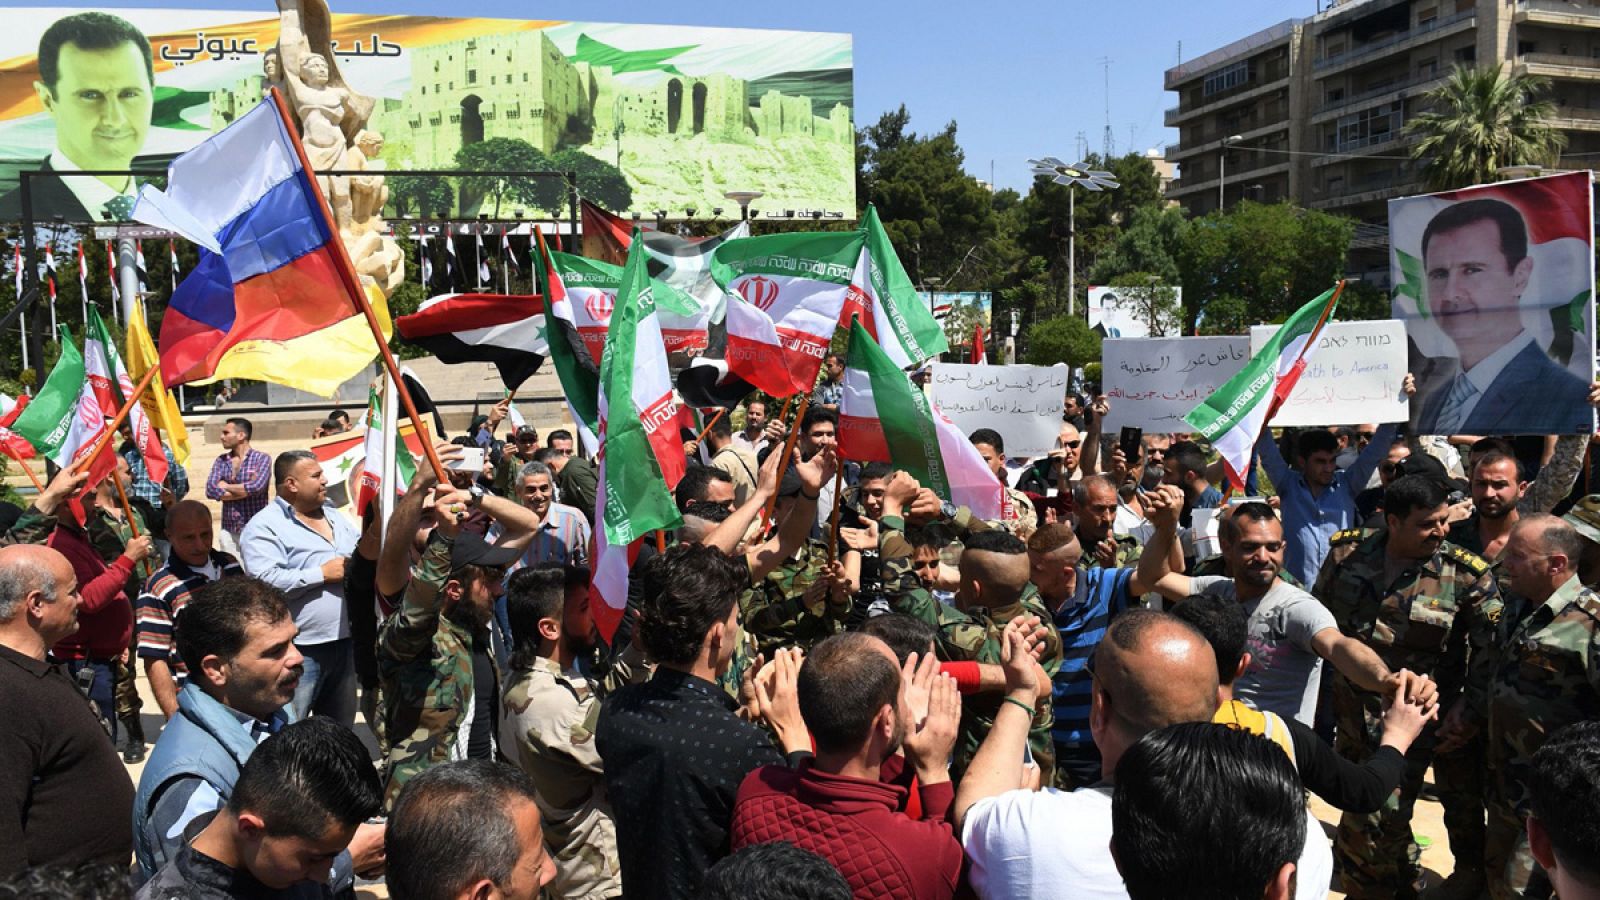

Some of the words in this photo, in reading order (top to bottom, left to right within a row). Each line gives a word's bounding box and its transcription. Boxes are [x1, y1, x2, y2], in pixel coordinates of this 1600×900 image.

[331, 35, 402, 62] حلب
[1302, 363, 1325, 378] eath
[1332, 363, 1344, 378] to
[1350, 361, 1389, 375] America
